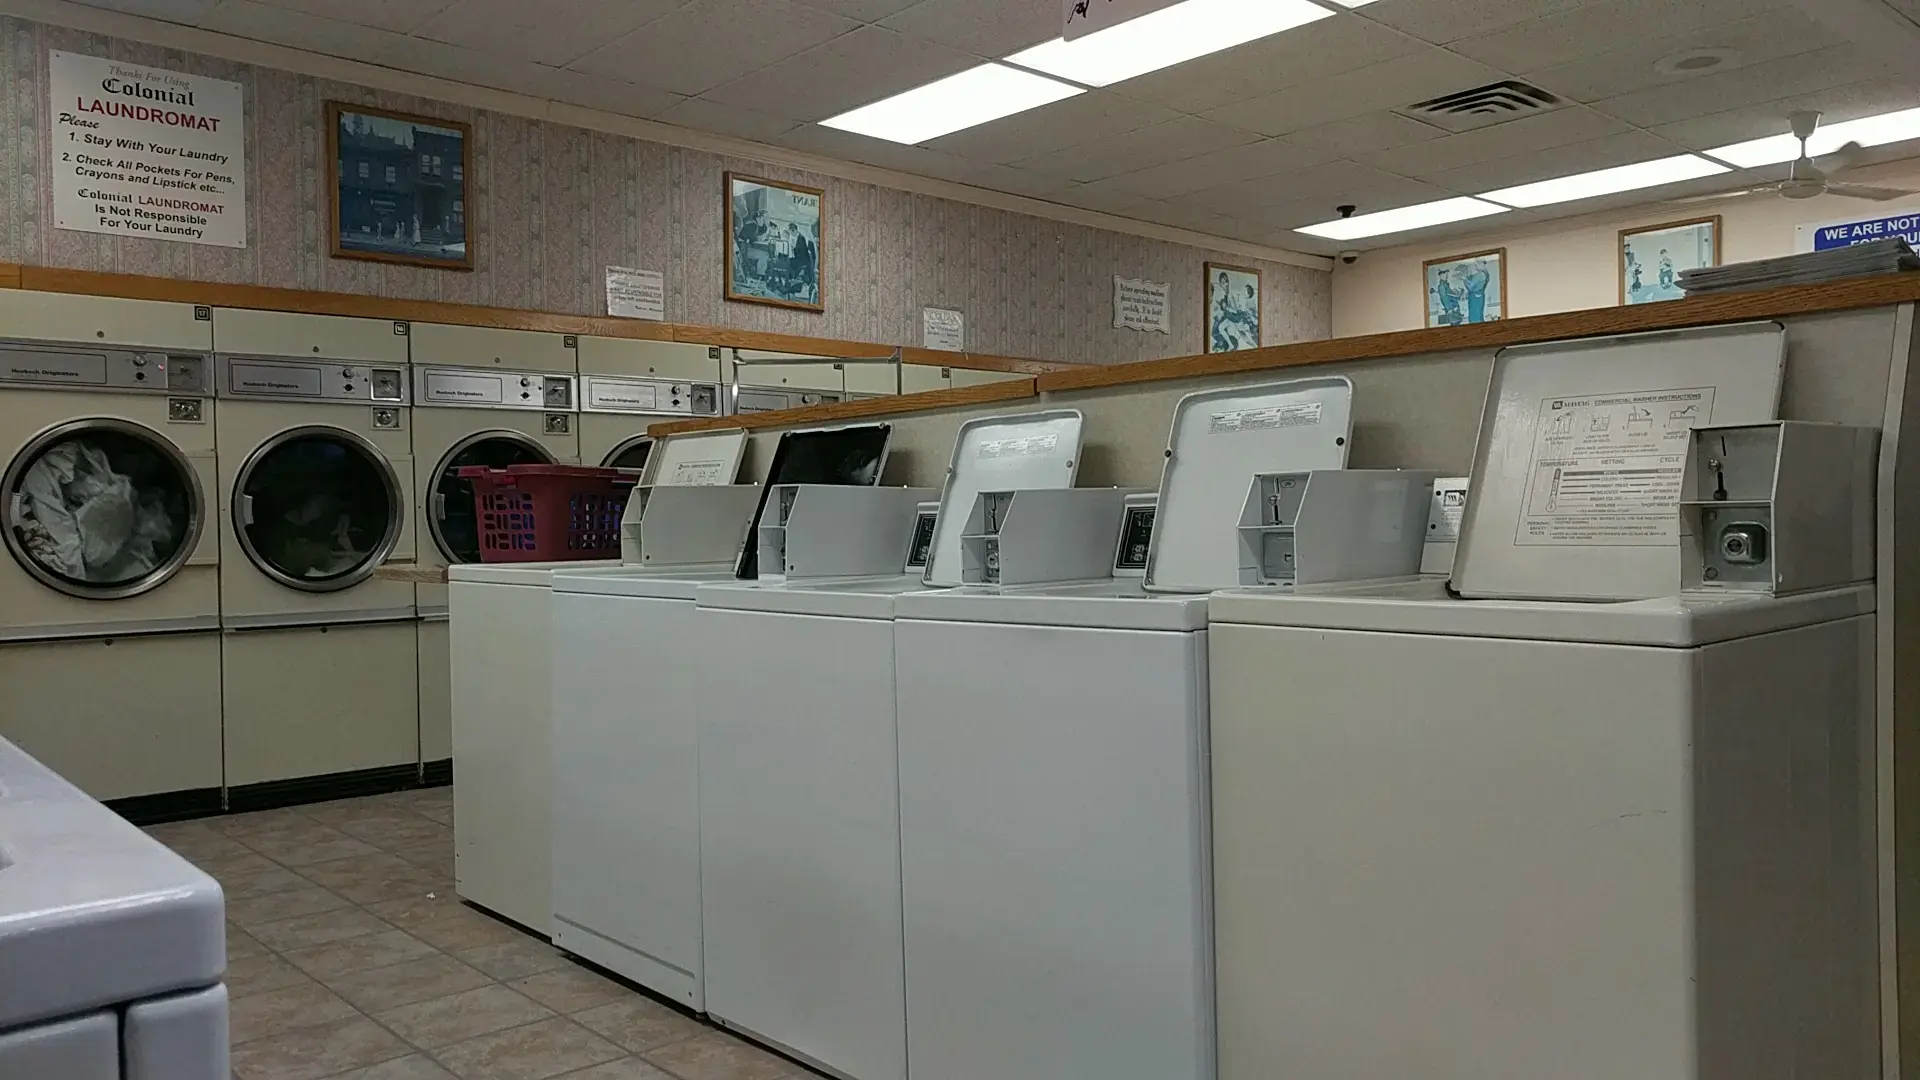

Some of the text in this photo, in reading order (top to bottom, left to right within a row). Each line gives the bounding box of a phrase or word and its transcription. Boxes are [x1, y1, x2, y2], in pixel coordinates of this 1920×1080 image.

[109, 65, 192, 89] Thanks For Using
[102, 78, 195, 106] Colonial
[59, 113, 100, 129] Please
[77, 97, 220, 132] LAUNDROMAT
[69, 132, 228, 164] 1. Stay With Your Laundry
[62, 152, 235, 185] 2. Check All Pockets For Pens,
[75, 167, 225, 194] Crayons and Lipstick etc...
[78, 189, 224, 214] Colonial LAUNDROMAT
[95, 204, 207, 225] Is Not Responsible
[100, 218, 203, 238] For Your Laundry
[1825, 217, 1920, 240] WE ARE NOT
